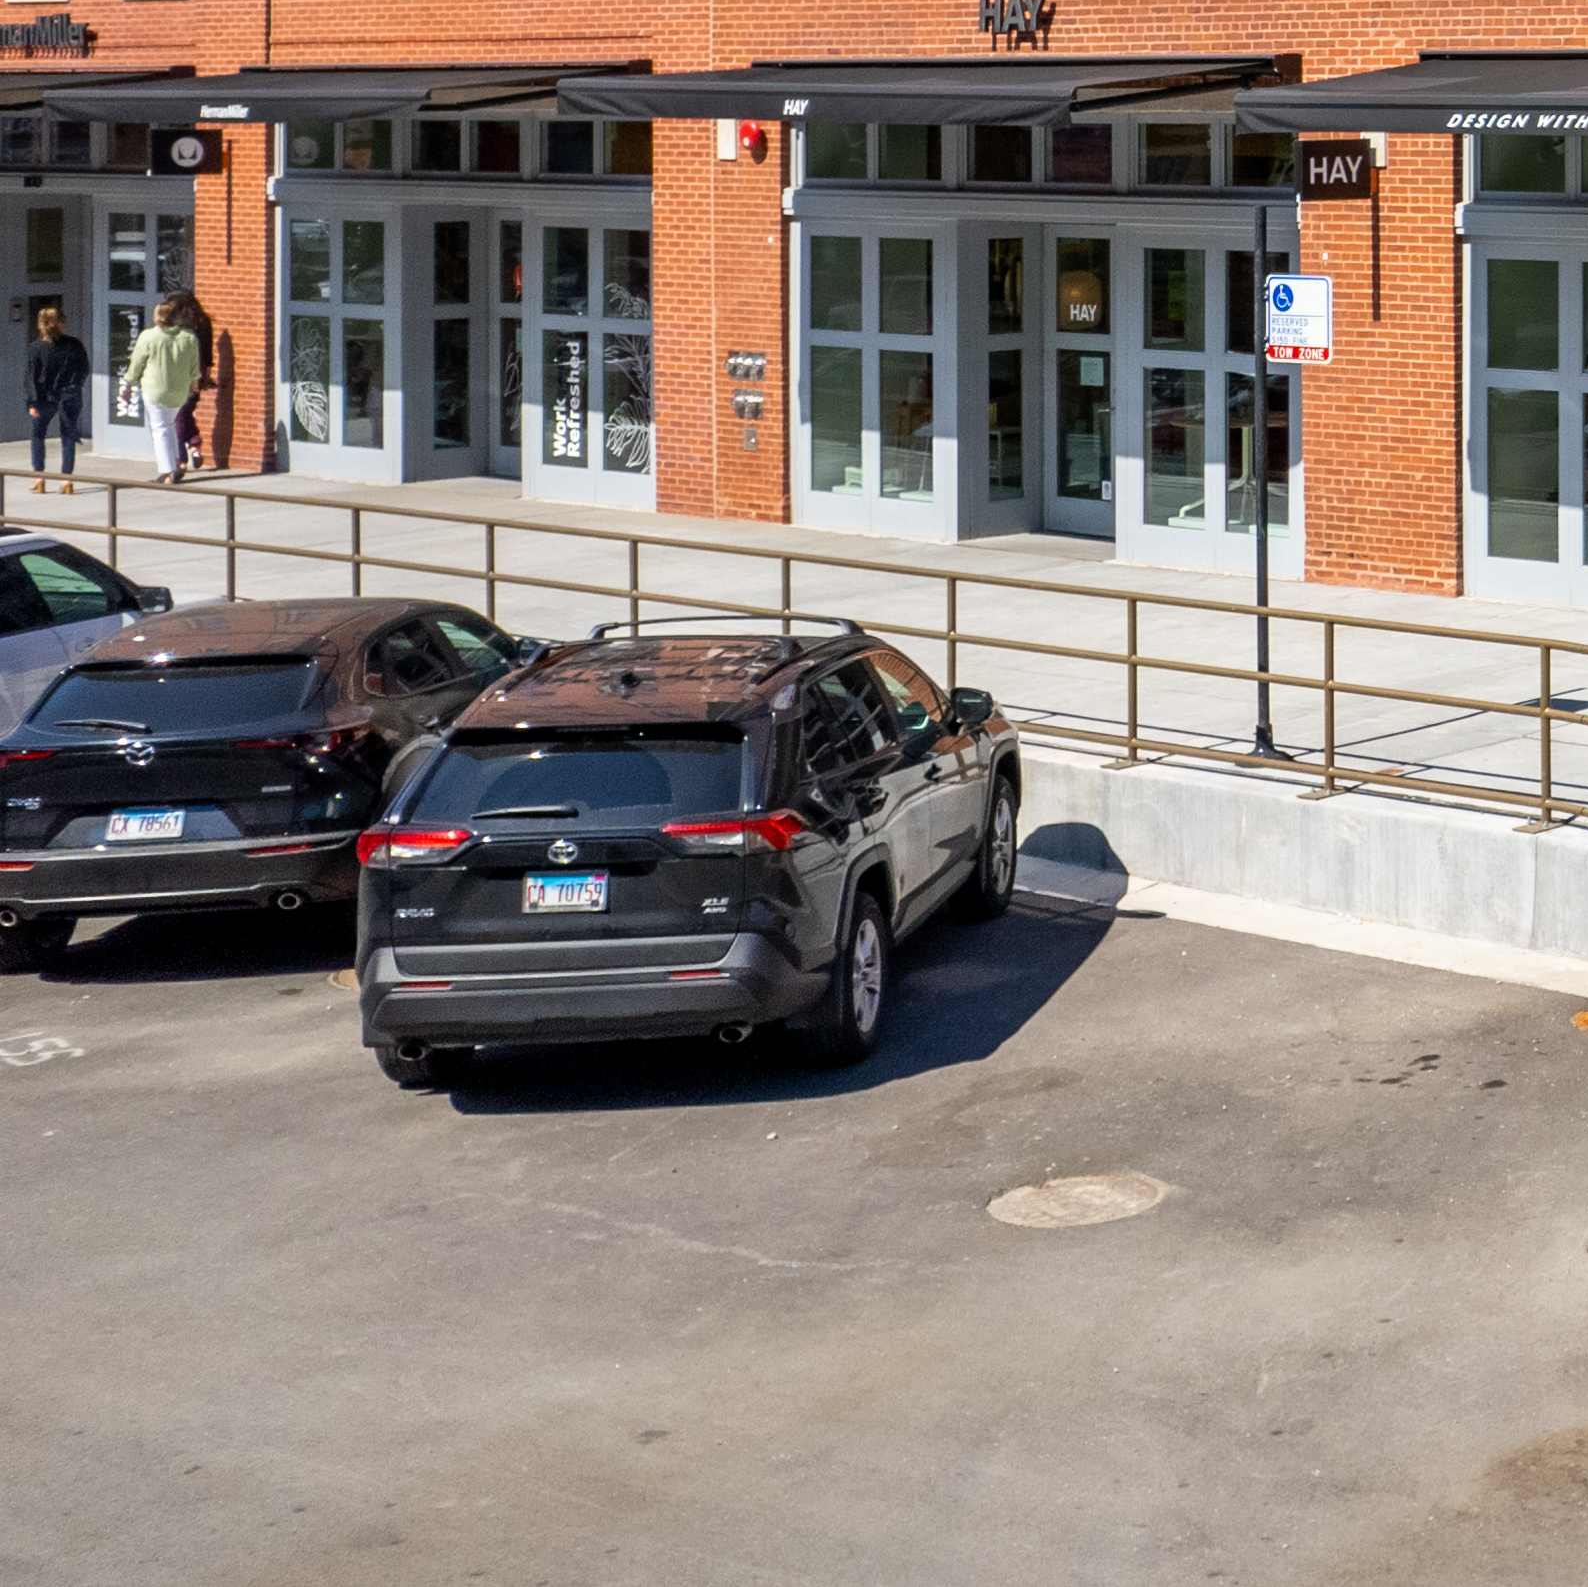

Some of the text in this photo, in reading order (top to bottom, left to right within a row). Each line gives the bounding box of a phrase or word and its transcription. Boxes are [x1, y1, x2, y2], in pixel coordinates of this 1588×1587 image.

[783, 99, 810, 115] HAY
[1446, 113, 1530, 129] DESIGN
[1309, 155, 1363, 185] HAY
[1069, 303, 1097, 322] HAY
[1271, 317, 1308, 327] RESERVED
[1271, 326, 1303, 335] PARKING
[1292, 337, 1308, 346] FINE
[1273, 346, 1325, 360] TOW ZONE
[566, 340, 581, 458] Refreshed
[553, 397, 567, 457] Work
[110, 814, 180, 834] CX 78561
[528, 882, 603, 904] CA 70759
